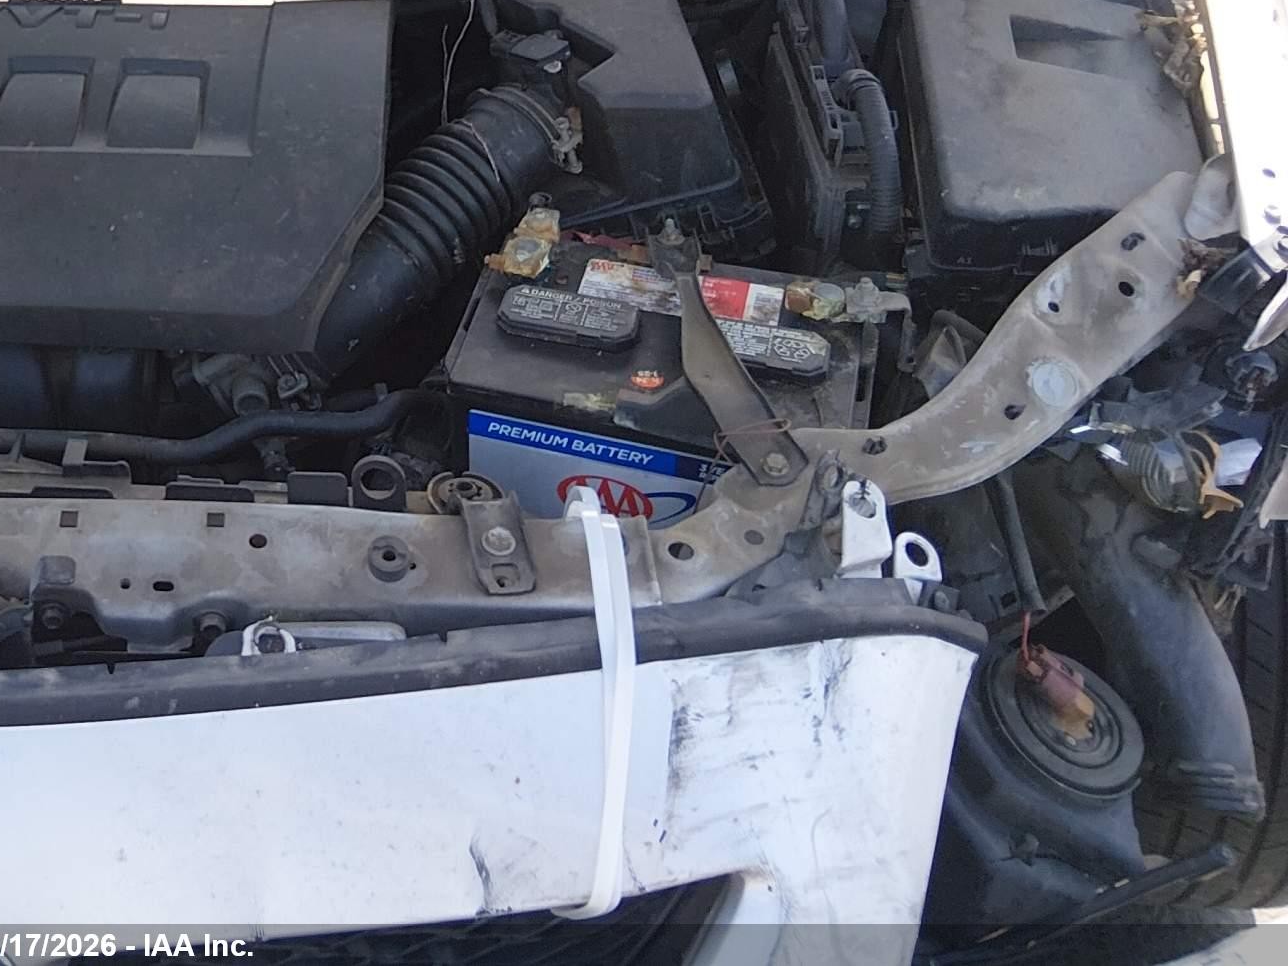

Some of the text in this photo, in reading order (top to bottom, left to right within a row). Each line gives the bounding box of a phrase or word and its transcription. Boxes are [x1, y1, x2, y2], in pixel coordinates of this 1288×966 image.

[531, 289, 573, 301] DANGER
[487, 422, 654, 466] PREMIUM BATTERY
